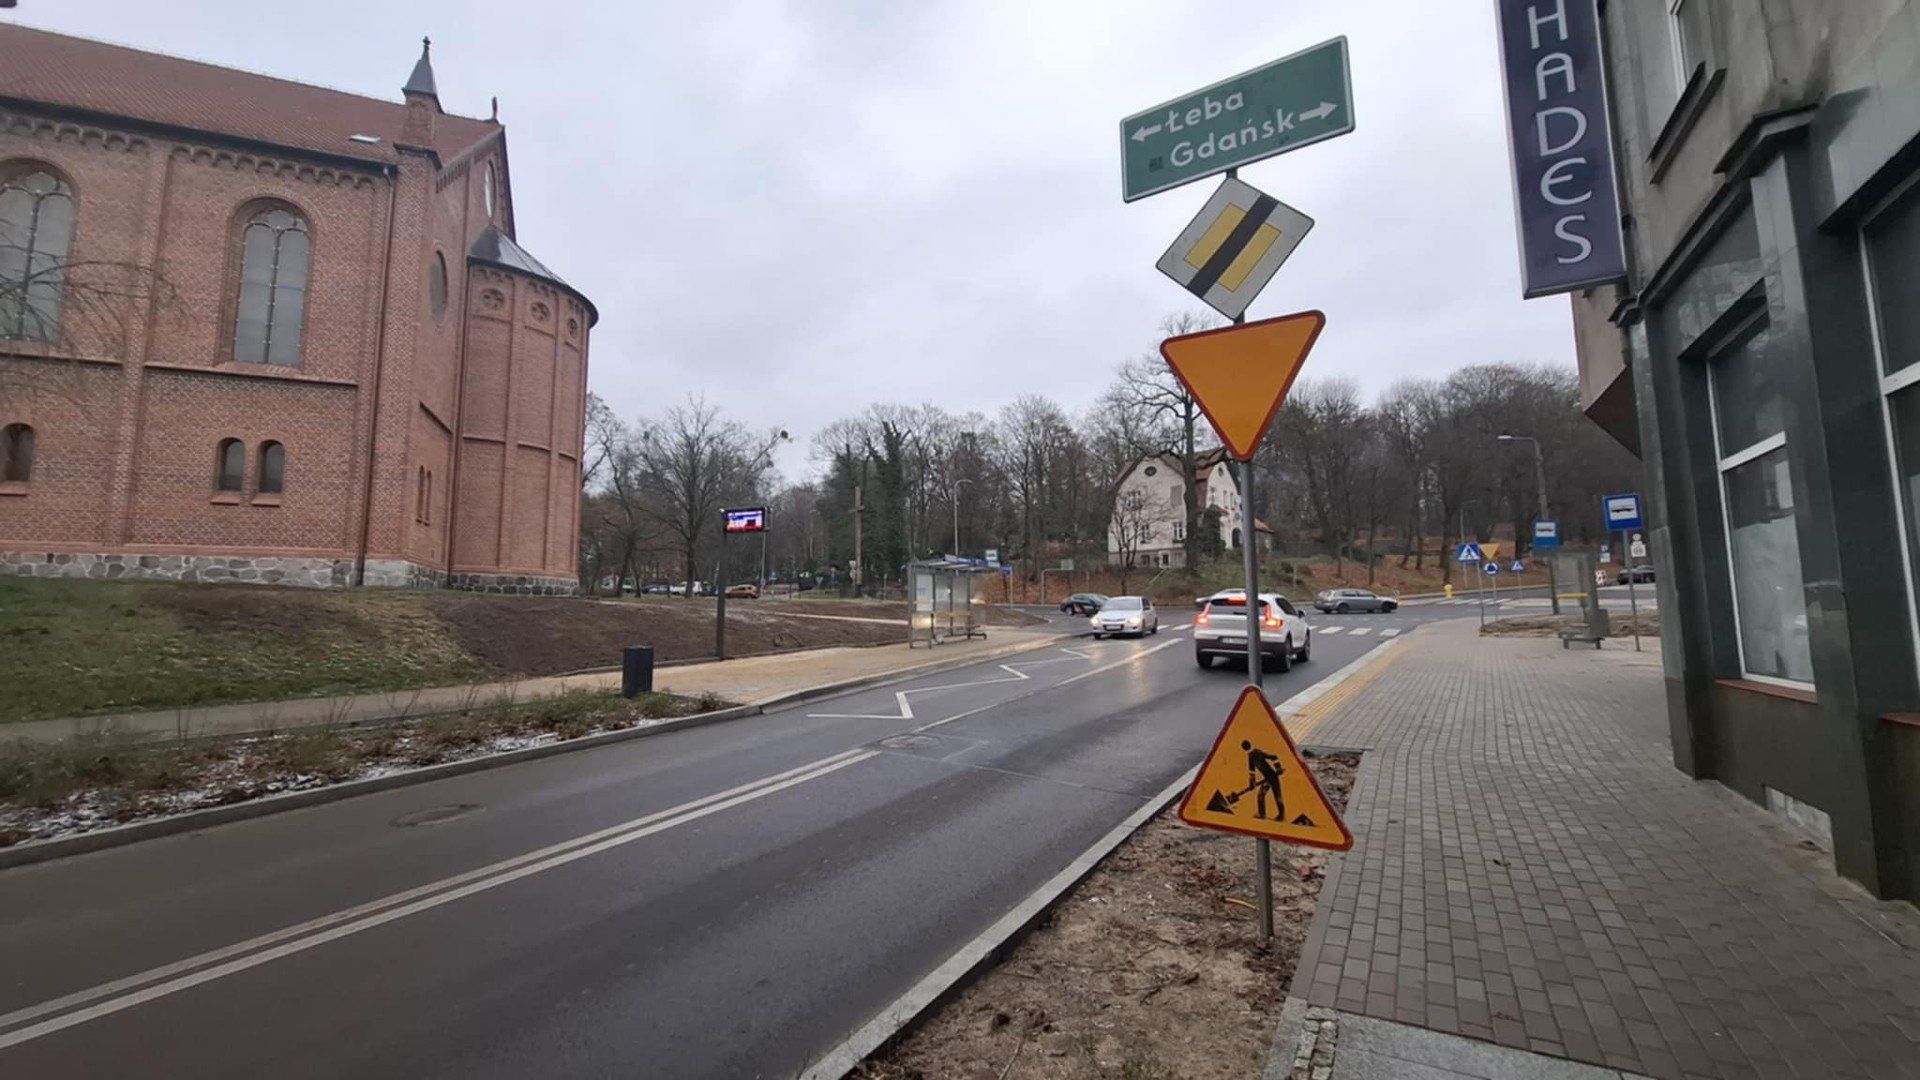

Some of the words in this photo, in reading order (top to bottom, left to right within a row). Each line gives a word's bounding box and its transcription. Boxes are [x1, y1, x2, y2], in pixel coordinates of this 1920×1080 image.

[1165, 91, 1244, 133] Łeba
[1170, 108, 1295, 167] Gdańsk
[1527, 0, 1593, 264] HADES
